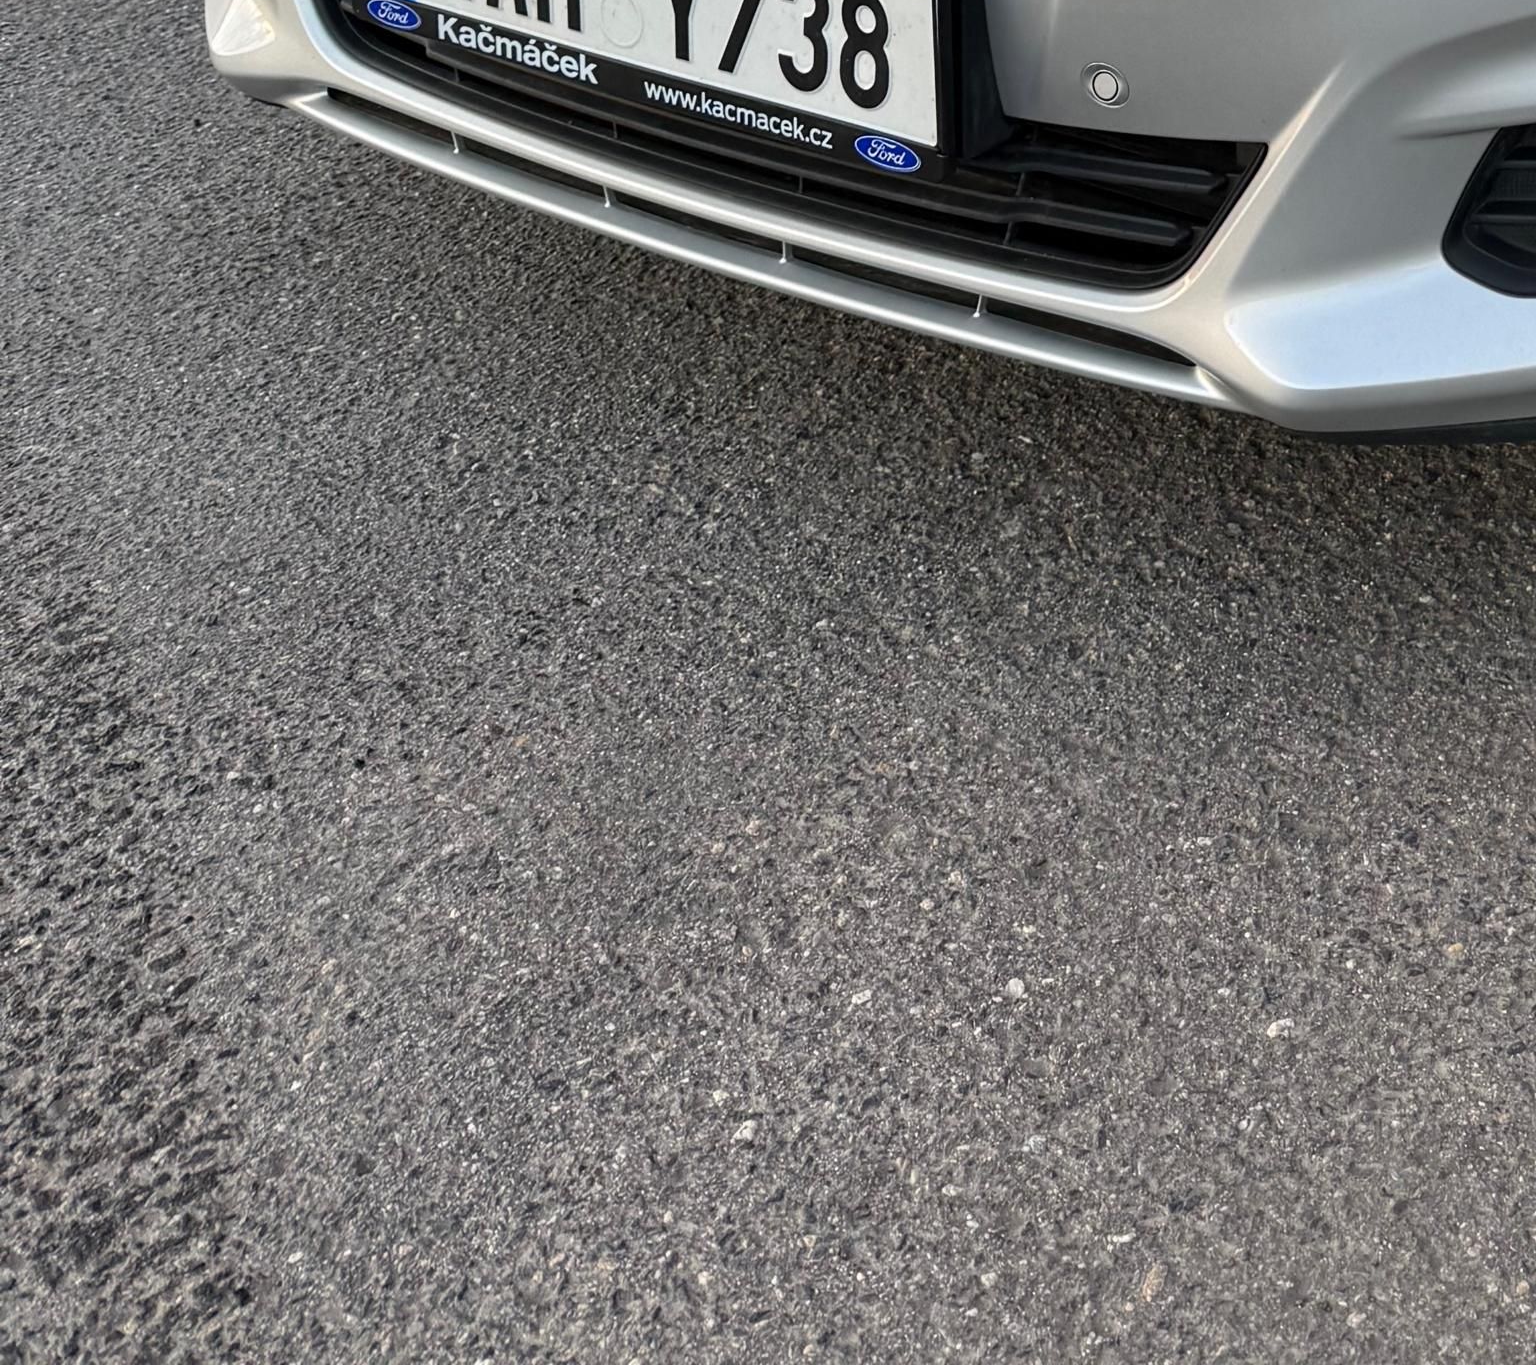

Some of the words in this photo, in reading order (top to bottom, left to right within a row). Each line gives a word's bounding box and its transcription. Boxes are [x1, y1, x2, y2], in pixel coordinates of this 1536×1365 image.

[377, 0, 410, 25] Ford
[437, 13, 599, 85] Kačmáček
[644, 81, 833, 149] www.kacmacek.cz
[866, 138, 906, 166] Ford
